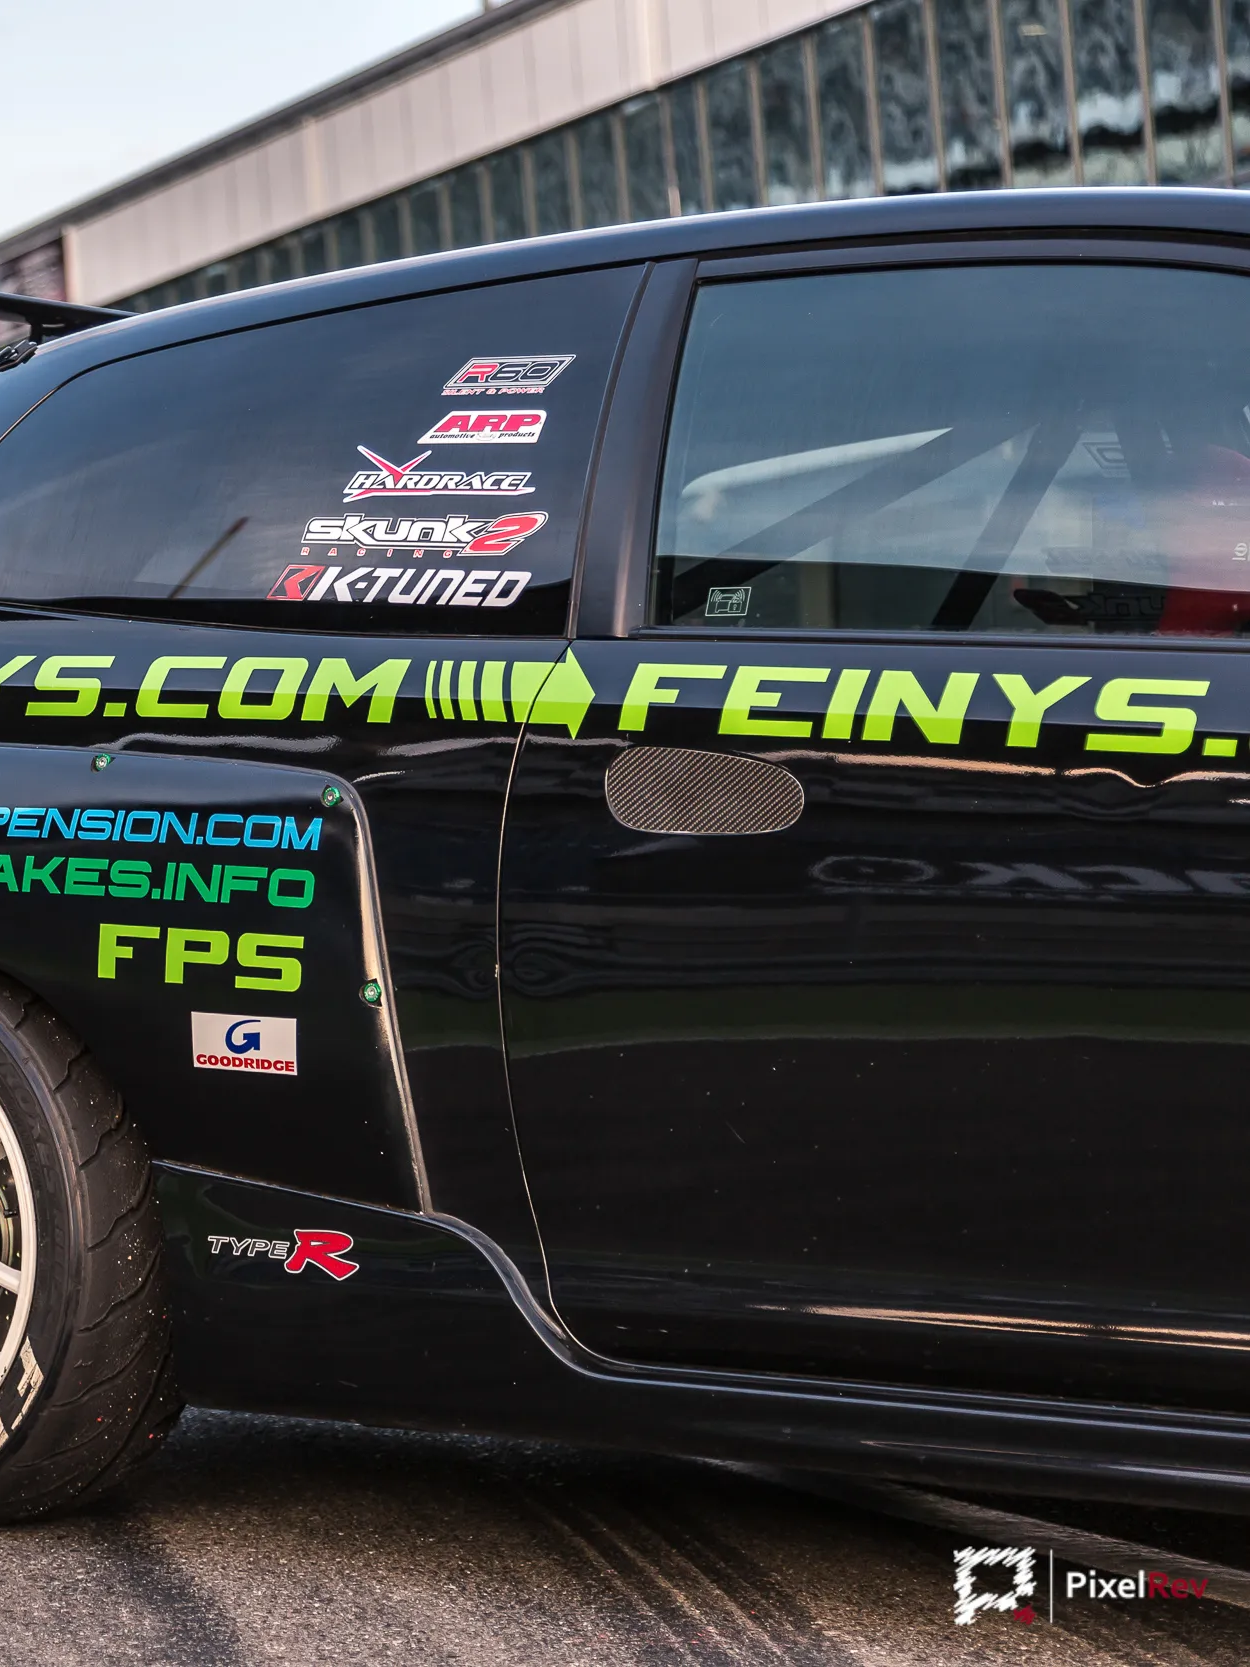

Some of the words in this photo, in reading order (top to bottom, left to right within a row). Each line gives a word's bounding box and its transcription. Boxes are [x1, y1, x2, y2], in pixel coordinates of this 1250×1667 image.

[433, 414, 541, 432] ARP
[349, 472, 528, 492] HARDRACE
[300, 547, 453, 558] RACING
[307, 565, 532, 607] K-TUNED
[97, 923, 305, 992] FPS
[196, 1053, 295, 1072] GOODRIDGE
[207, 1235, 290, 1259] TYPE
[284, 1228, 360, 1281] R
